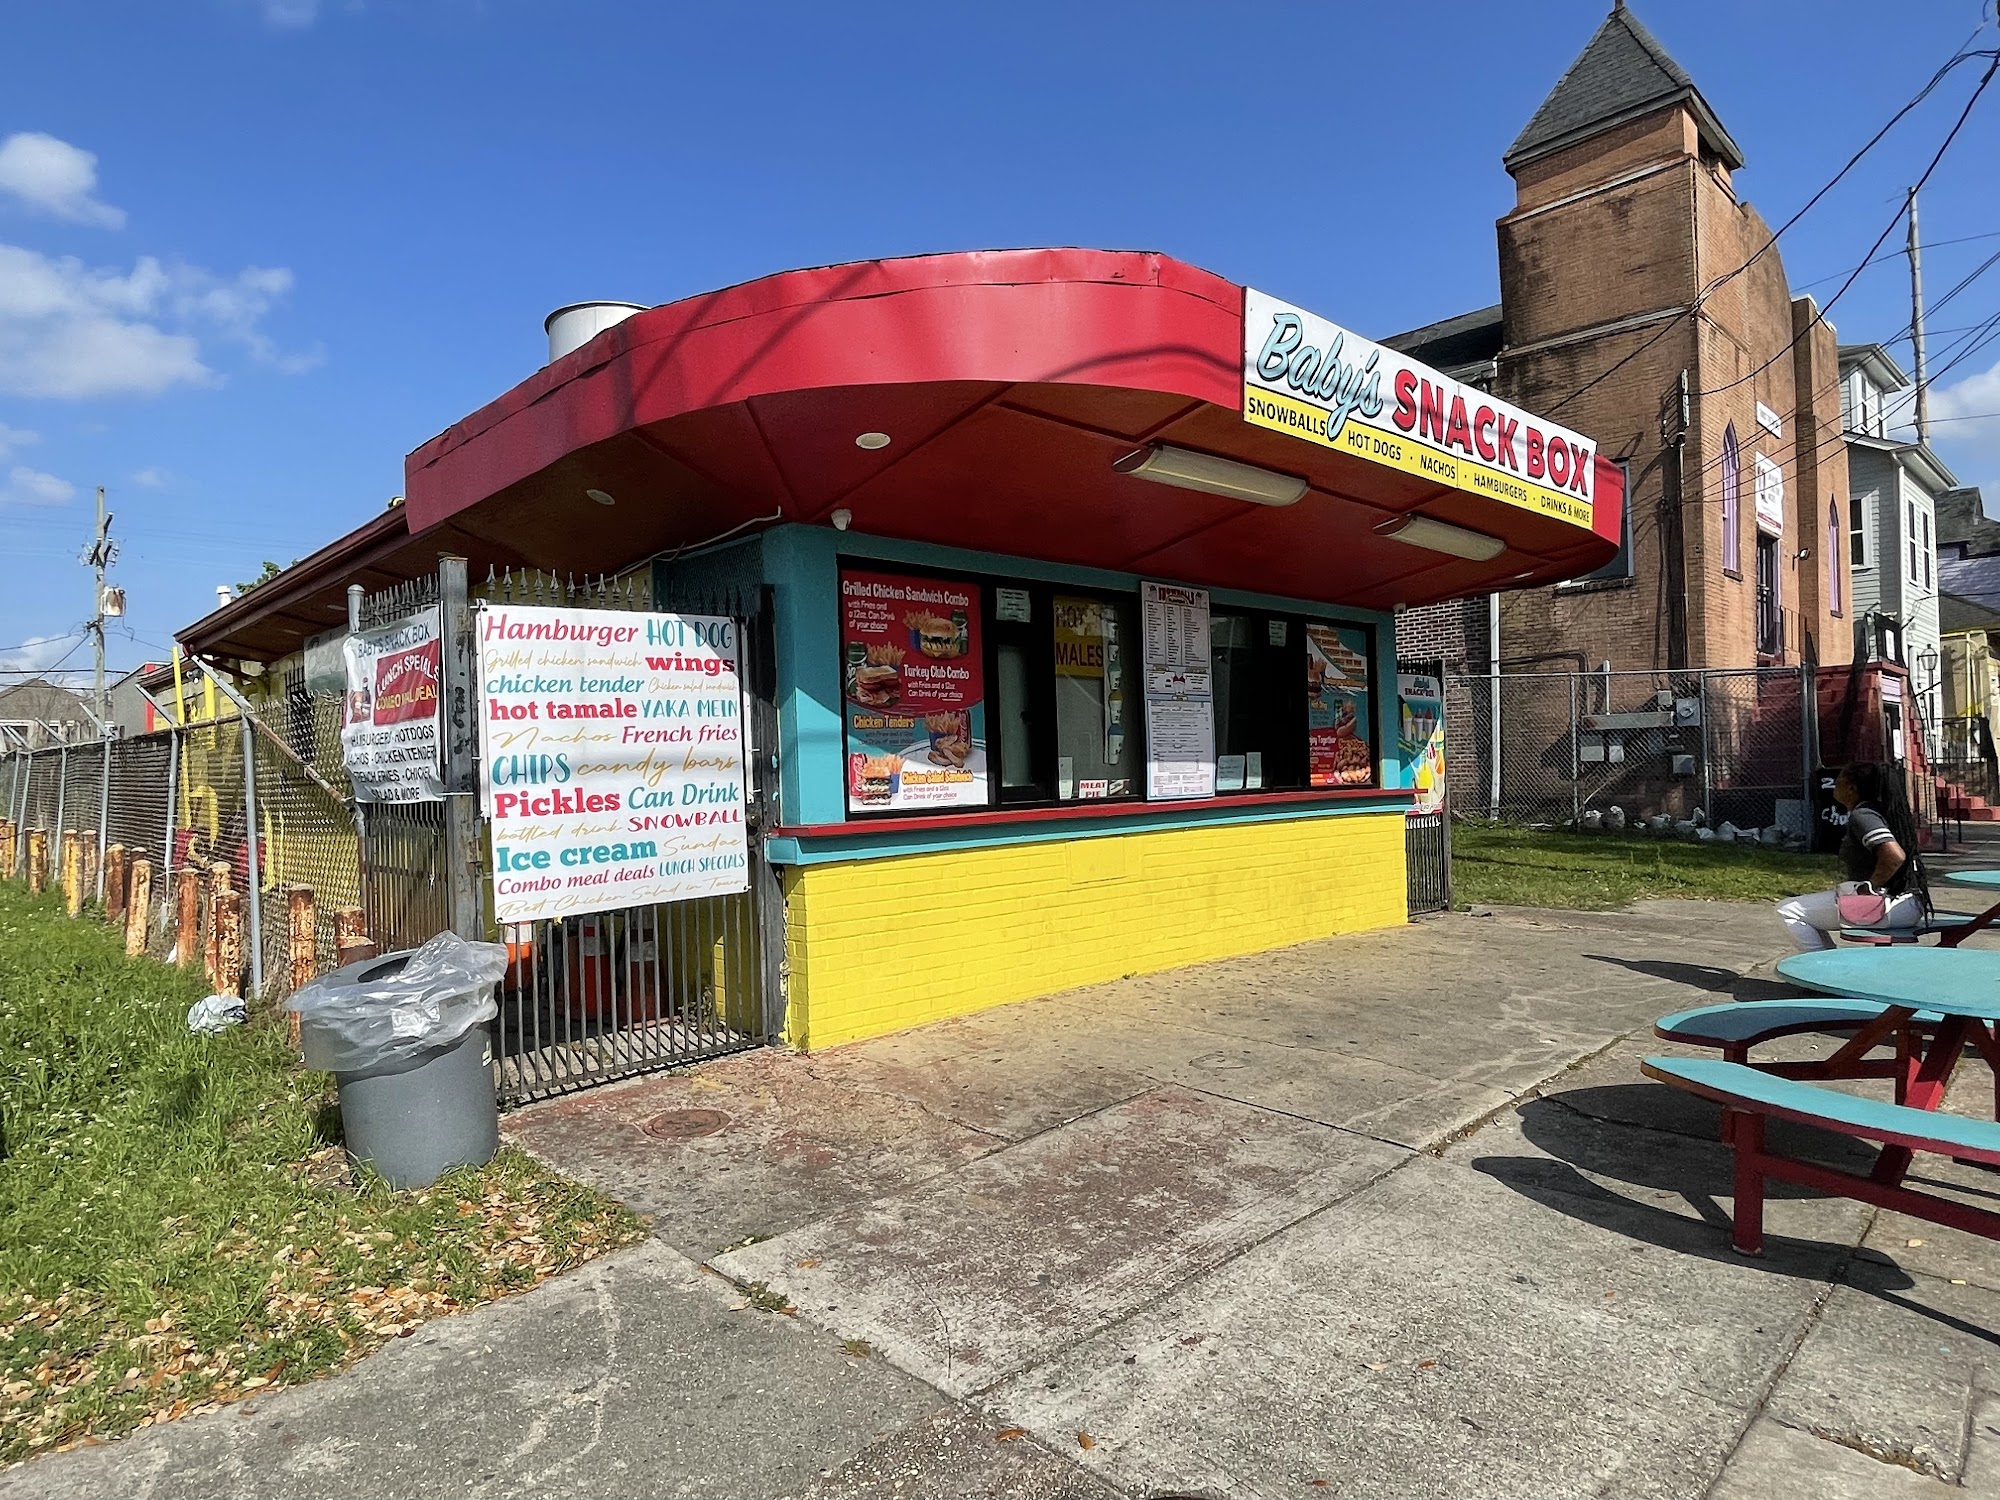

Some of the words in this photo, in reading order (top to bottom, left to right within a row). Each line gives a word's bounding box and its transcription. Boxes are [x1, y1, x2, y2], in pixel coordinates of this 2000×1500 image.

[1257, 313, 1383, 441] Baby's
[1392, 368, 1518, 472] SNACK
[1526, 425, 1589, 497] BOX
[1248, 396, 1326, 437] SNOWBALLS
[1348, 430, 1370, 451] HOT
[1373, 438, 1401, 461] DOGS
[1420, 455, 1456, 480] NACHOS
[1474, 472, 1527, 502] HAMBURGERS
[1541, 495, 1567, 514] DRINKS
[1567, 504, 1573, 516] &
[1573, 506, 1590, 523] MORE
[842, 580, 872, 597] Grilled
[873, 583, 904, 600] Chicken
[906, 586, 943, 603] Sandwich
[944, 591, 969, 606] Combo
[412, 622, 430, 642] BOX
[484, 613, 639, 647] Hamburger
[646, 619, 686, 647] HOT
[694, 621, 732, 649] DOG
[485, 648, 533, 673] Grilled
[537, 650, 584, 666] chicken
[587, 652, 643, 670] sandwich
[645, 651, 735, 677] wings
[903, 664, 930, 681] Turkey
[930, 665, 946, 678] Club
[947, 666, 969, 679] Combo
[376, 658, 404, 697] LUNCH
[486, 674, 573, 694] chicken
[579, 675, 645, 693] tender
[648, 677, 682, 693] Chicken
[683, 678, 704, 693] salad
[705, 680, 737, 693] sandwich
[376, 694, 401, 711] COMBO
[489, 699, 539, 720] hot
[546, 698, 638, 719] tamale
[641, 699, 691, 718] YAKA
[696, 699, 738, 718] MEIN
[395, 724, 434, 743] HOTDOGS
[853, 715, 883, 729] Chicken
[884, 715, 915, 729] Tenders
[491, 726, 618, 750] Nachos
[622, 725, 693, 744] French
[697, 724, 738, 745] fries
[348, 752, 369, 765] ACHOS
[374, 748, 407, 764] CHICKEN
[577, 747, 673, 788] candy
[683, 746, 739, 772] bars
[492, 752, 571, 786] CHIPS
[902, 771, 927, 784] Chicken
[394, 788, 401, 801] &
[401, 787, 420, 800] MORE
[494, 787, 621, 819] Pickles
[628, 786, 675, 810] Can
[681, 782, 739, 806] Drink
[496, 823, 564, 843] bottled
[571, 819, 623, 838] drink
[628, 808, 743, 833] SNOWBALL
[496, 846, 550, 872] Ice
[559, 840, 658, 867] cream
[662, 833, 742, 857] Sundae
[659, 858, 695, 877] LUNCH
[698, 853, 745, 873] SPECIALS
[497, 876, 561, 895] Combo
[567, 869, 609, 888] meal
[614, 864, 656, 882] deals
[497, 898, 555, 917] Best
[553, 891, 626, 912] Chicken
[631, 882, 681, 901] Salad
[686, 883, 702, 891] in
[702, 875, 747, 890] Town
